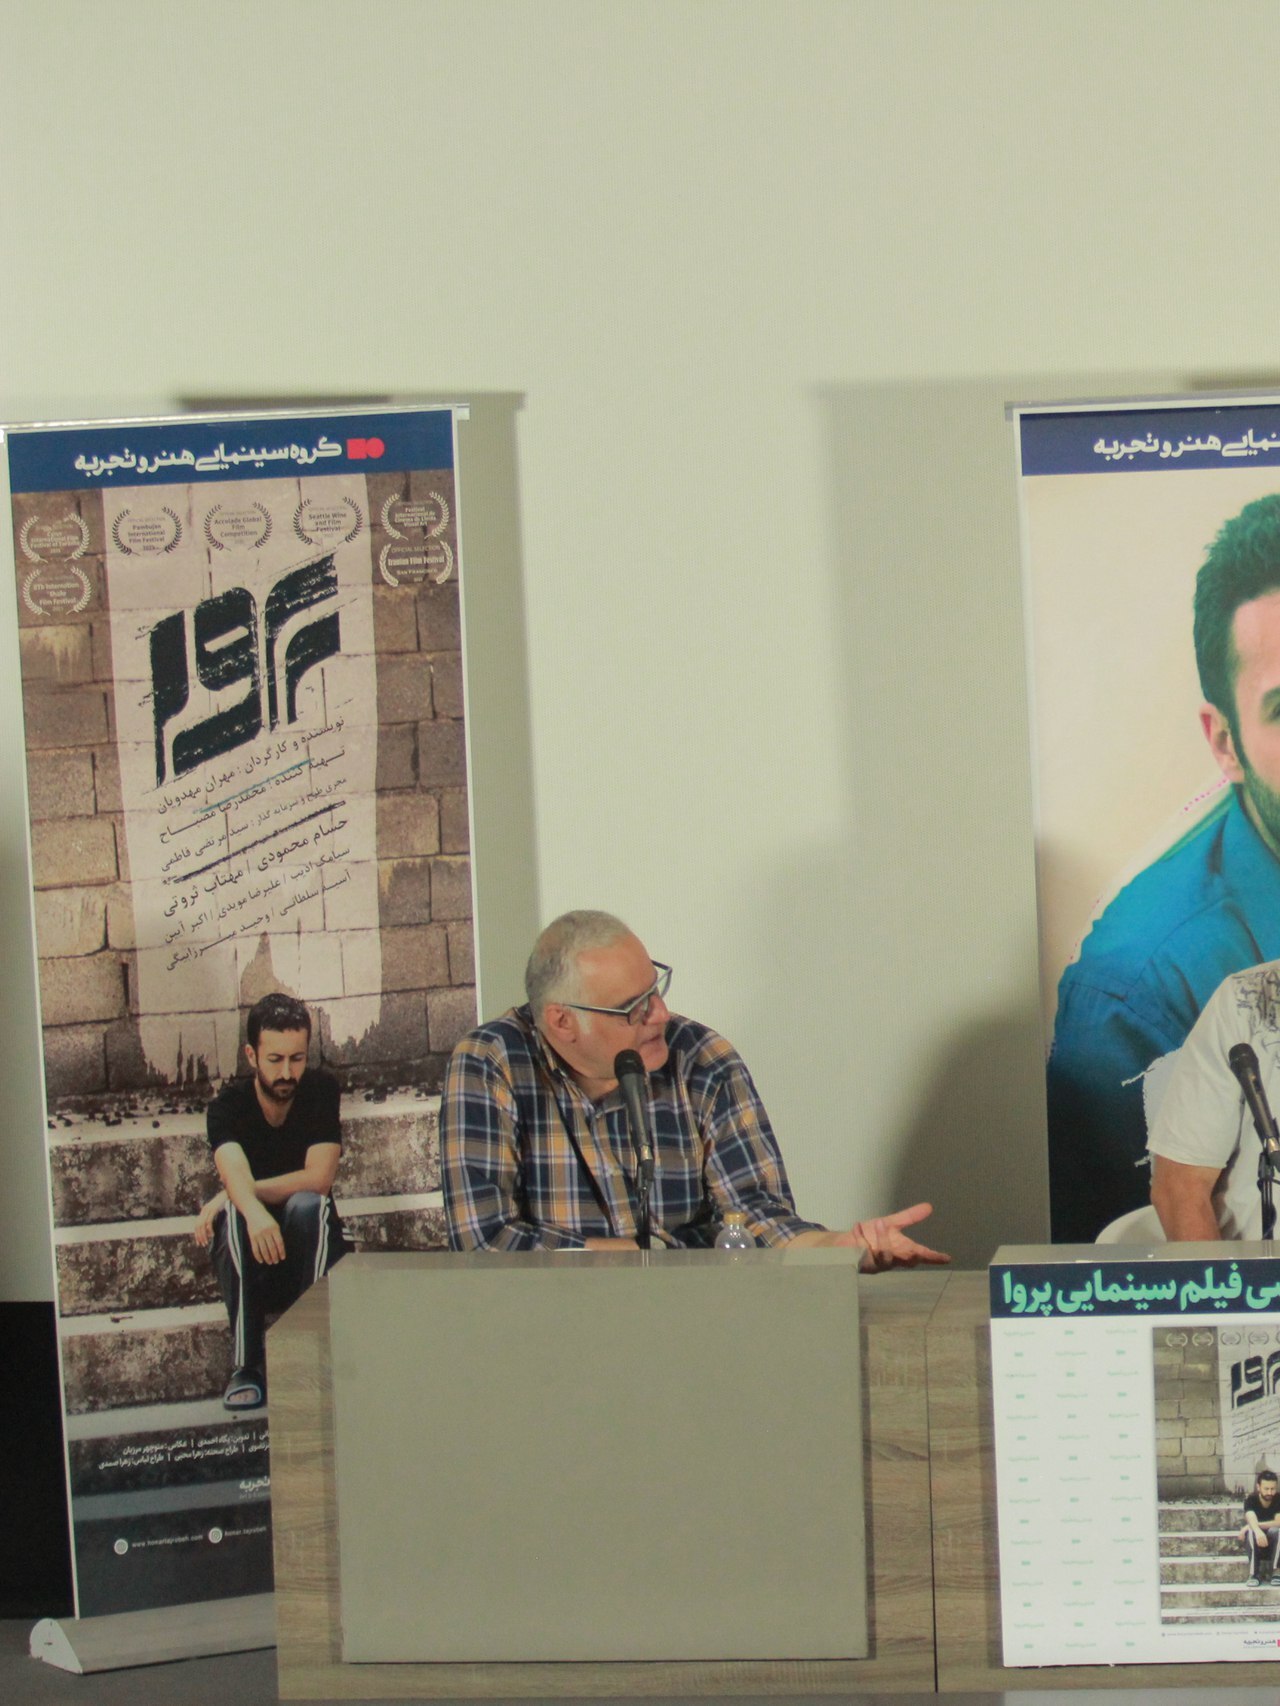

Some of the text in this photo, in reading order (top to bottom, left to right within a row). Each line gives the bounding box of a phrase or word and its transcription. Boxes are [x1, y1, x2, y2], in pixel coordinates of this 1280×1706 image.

[195, 442, 290, 471] سینمایی
[290, 436, 342, 465] گروه
[158, 715, 344, 814] نویسنده و کارگردان مهران مهدویان
[308, 745, 346, 769] تهیه
[275, 765, 303, 786] کننده
[160, 810, 216, 844] مصباح
[228, 822, 248, 836] سید
[161, 847, 192, 872] فاطمی
[164, 820, 348, 918] حسام محمودی مهتاب ثروتی
[290, 861, 314, 880] ادیب
[316, 848, 350, 868] سیامک
[248, 880, 280, 900] علیرضا
[280, 889, 320, 916] سلطانی
[192, 912, 208, 932] اکبر
[240, 914, 270, 932] وحید
[1002, 1270, 1054, 1317] پروا
[1056, 1268, 1177, 1314] سینمایی
[1180, 1262, 1243, 1312] فیلم
